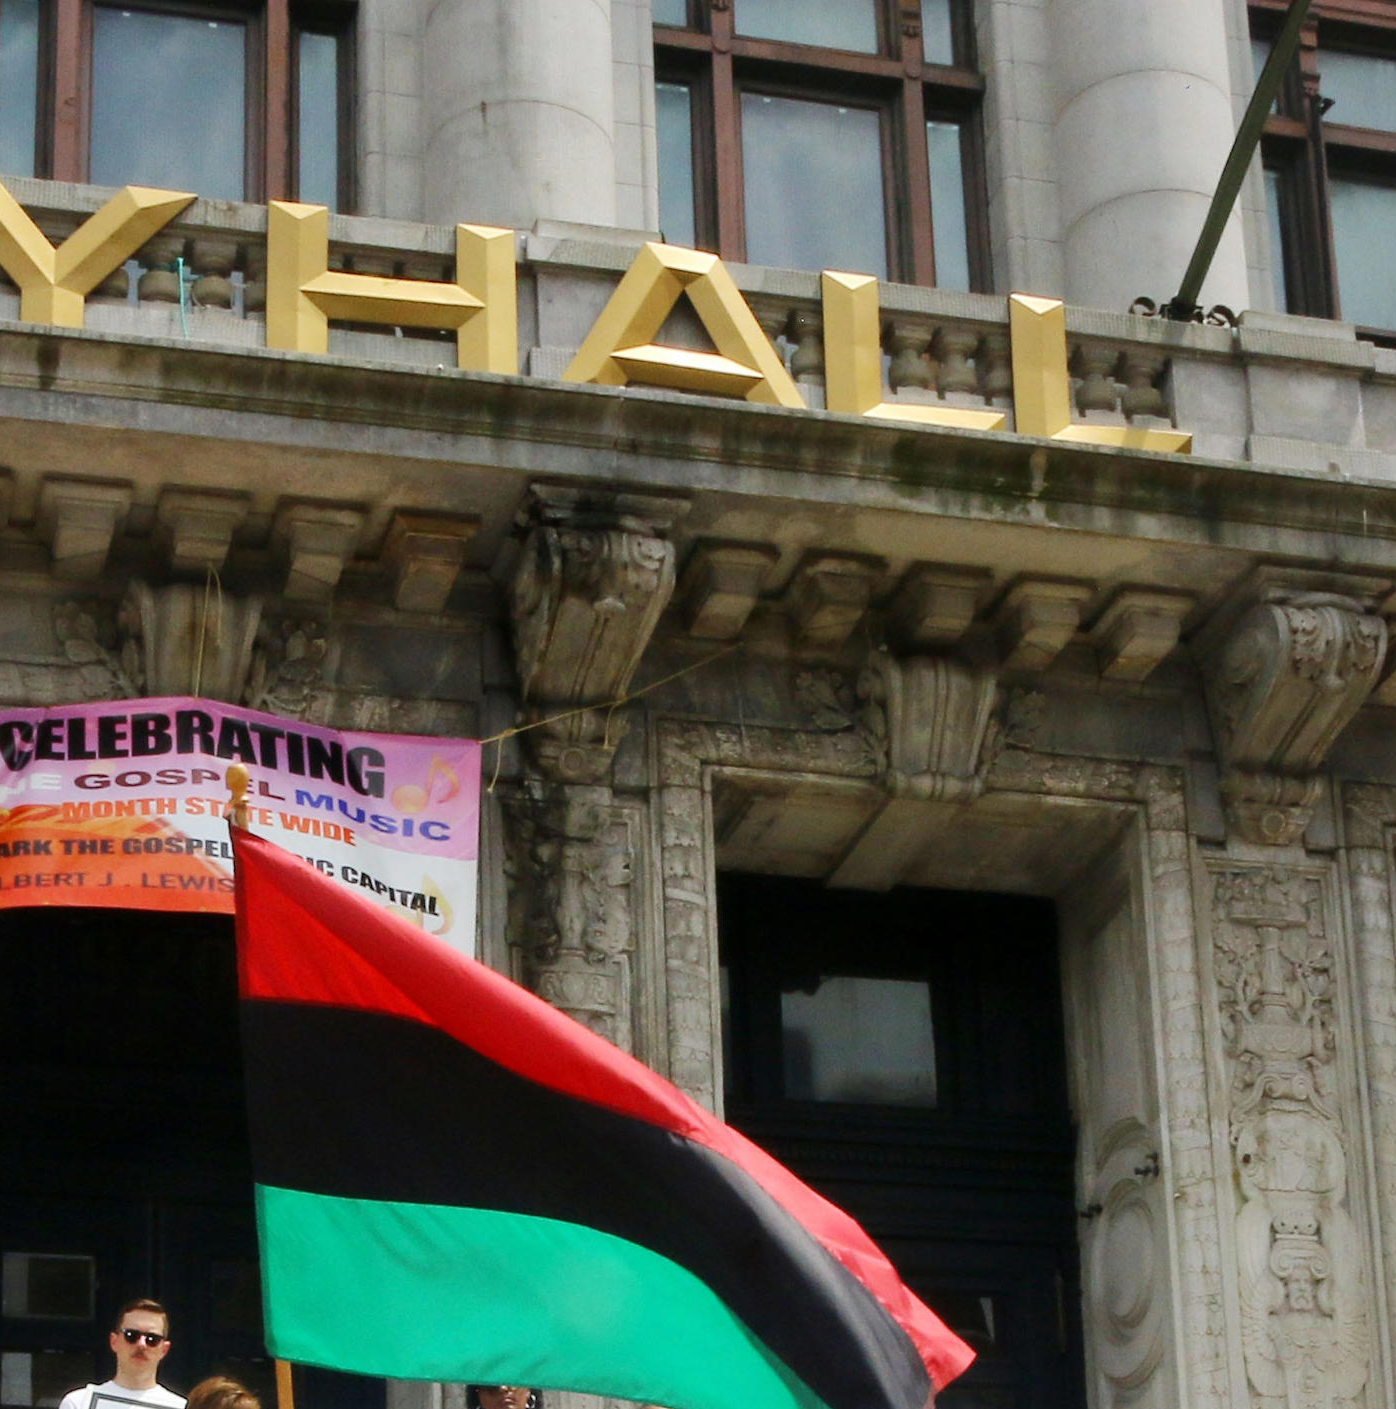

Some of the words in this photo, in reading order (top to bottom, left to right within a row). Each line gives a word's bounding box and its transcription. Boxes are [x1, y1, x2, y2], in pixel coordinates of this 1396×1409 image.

[265, 200, 1193, 454] HALL
[62, 797, 177, 821] MONTH
[279, 812, 357, 847] WIDE
[295, 788, 452, 842] MUSIC
[60, 838, 115, 855] THE
[122, 837, 234, 860] GOSPEL
[341, 866, 440, 917] CAPITAL
[141, 872, 235, 893] LEWIS
